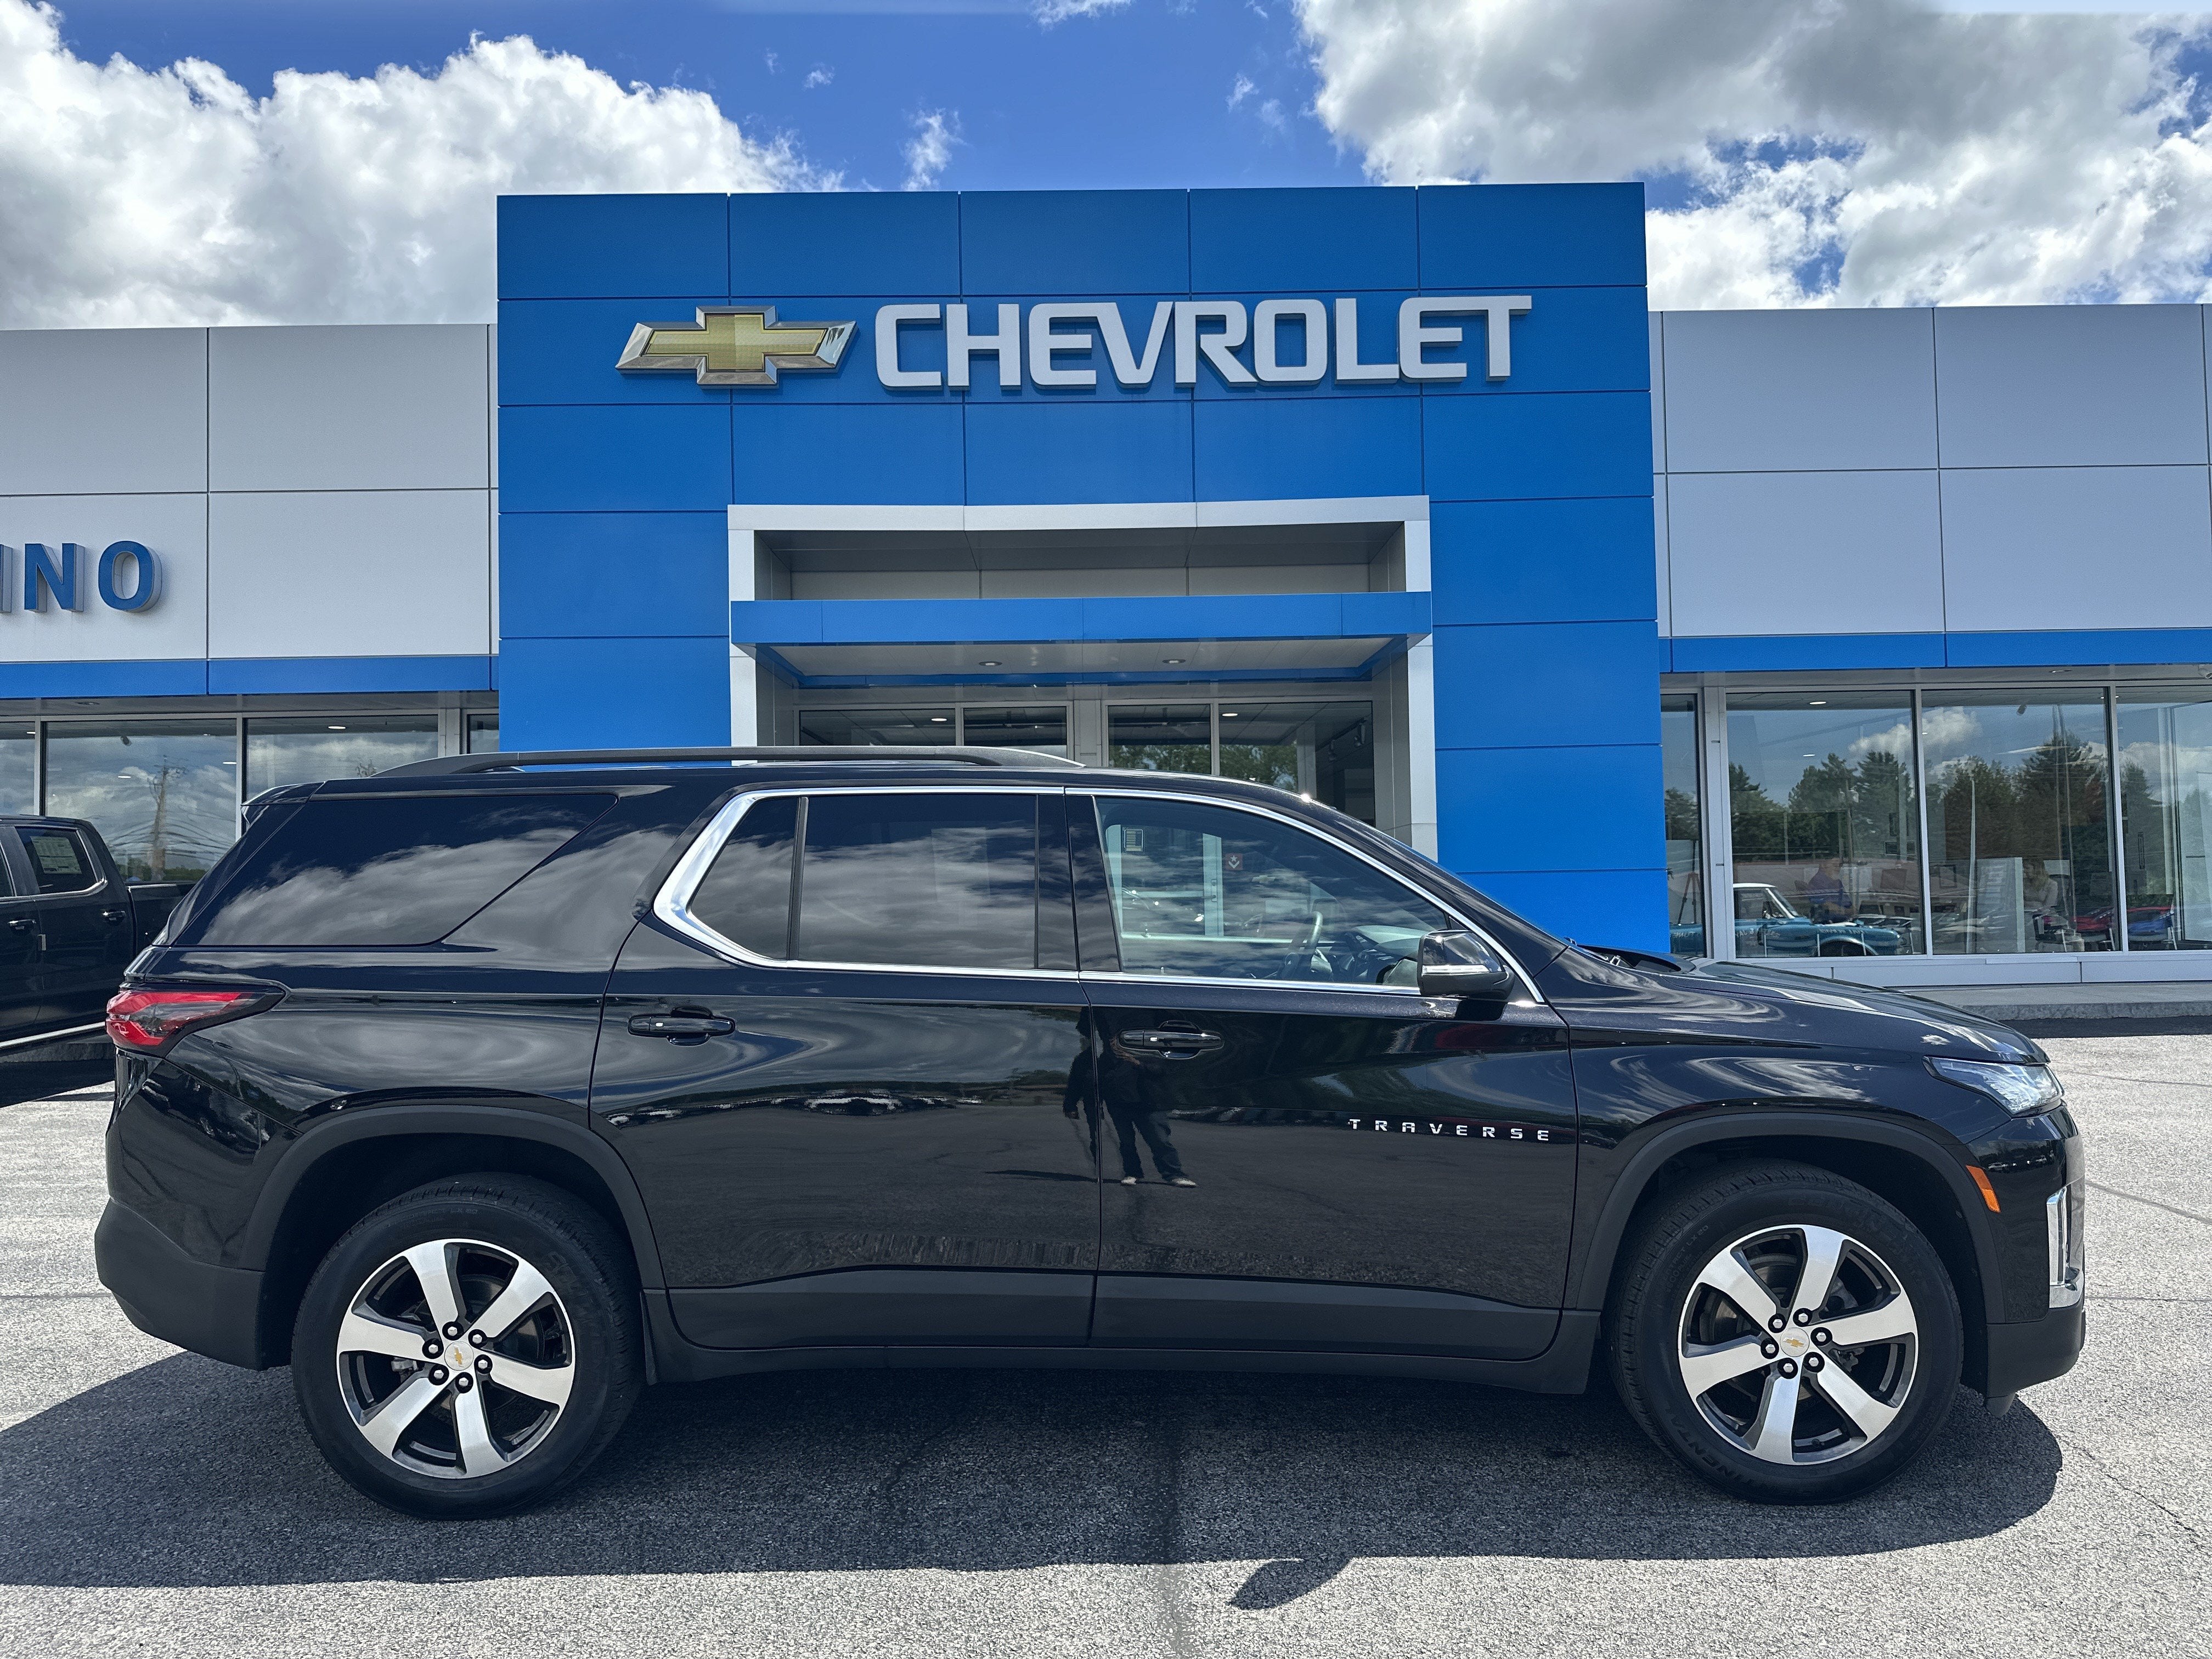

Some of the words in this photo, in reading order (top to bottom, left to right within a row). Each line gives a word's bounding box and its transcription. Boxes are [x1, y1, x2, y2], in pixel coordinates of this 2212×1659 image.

[875, 295, 1532, 391] CHEVROLET
[0, 540, 163, 613] NO
[1348, 1118, 1549, 1142] TRAVERSE
